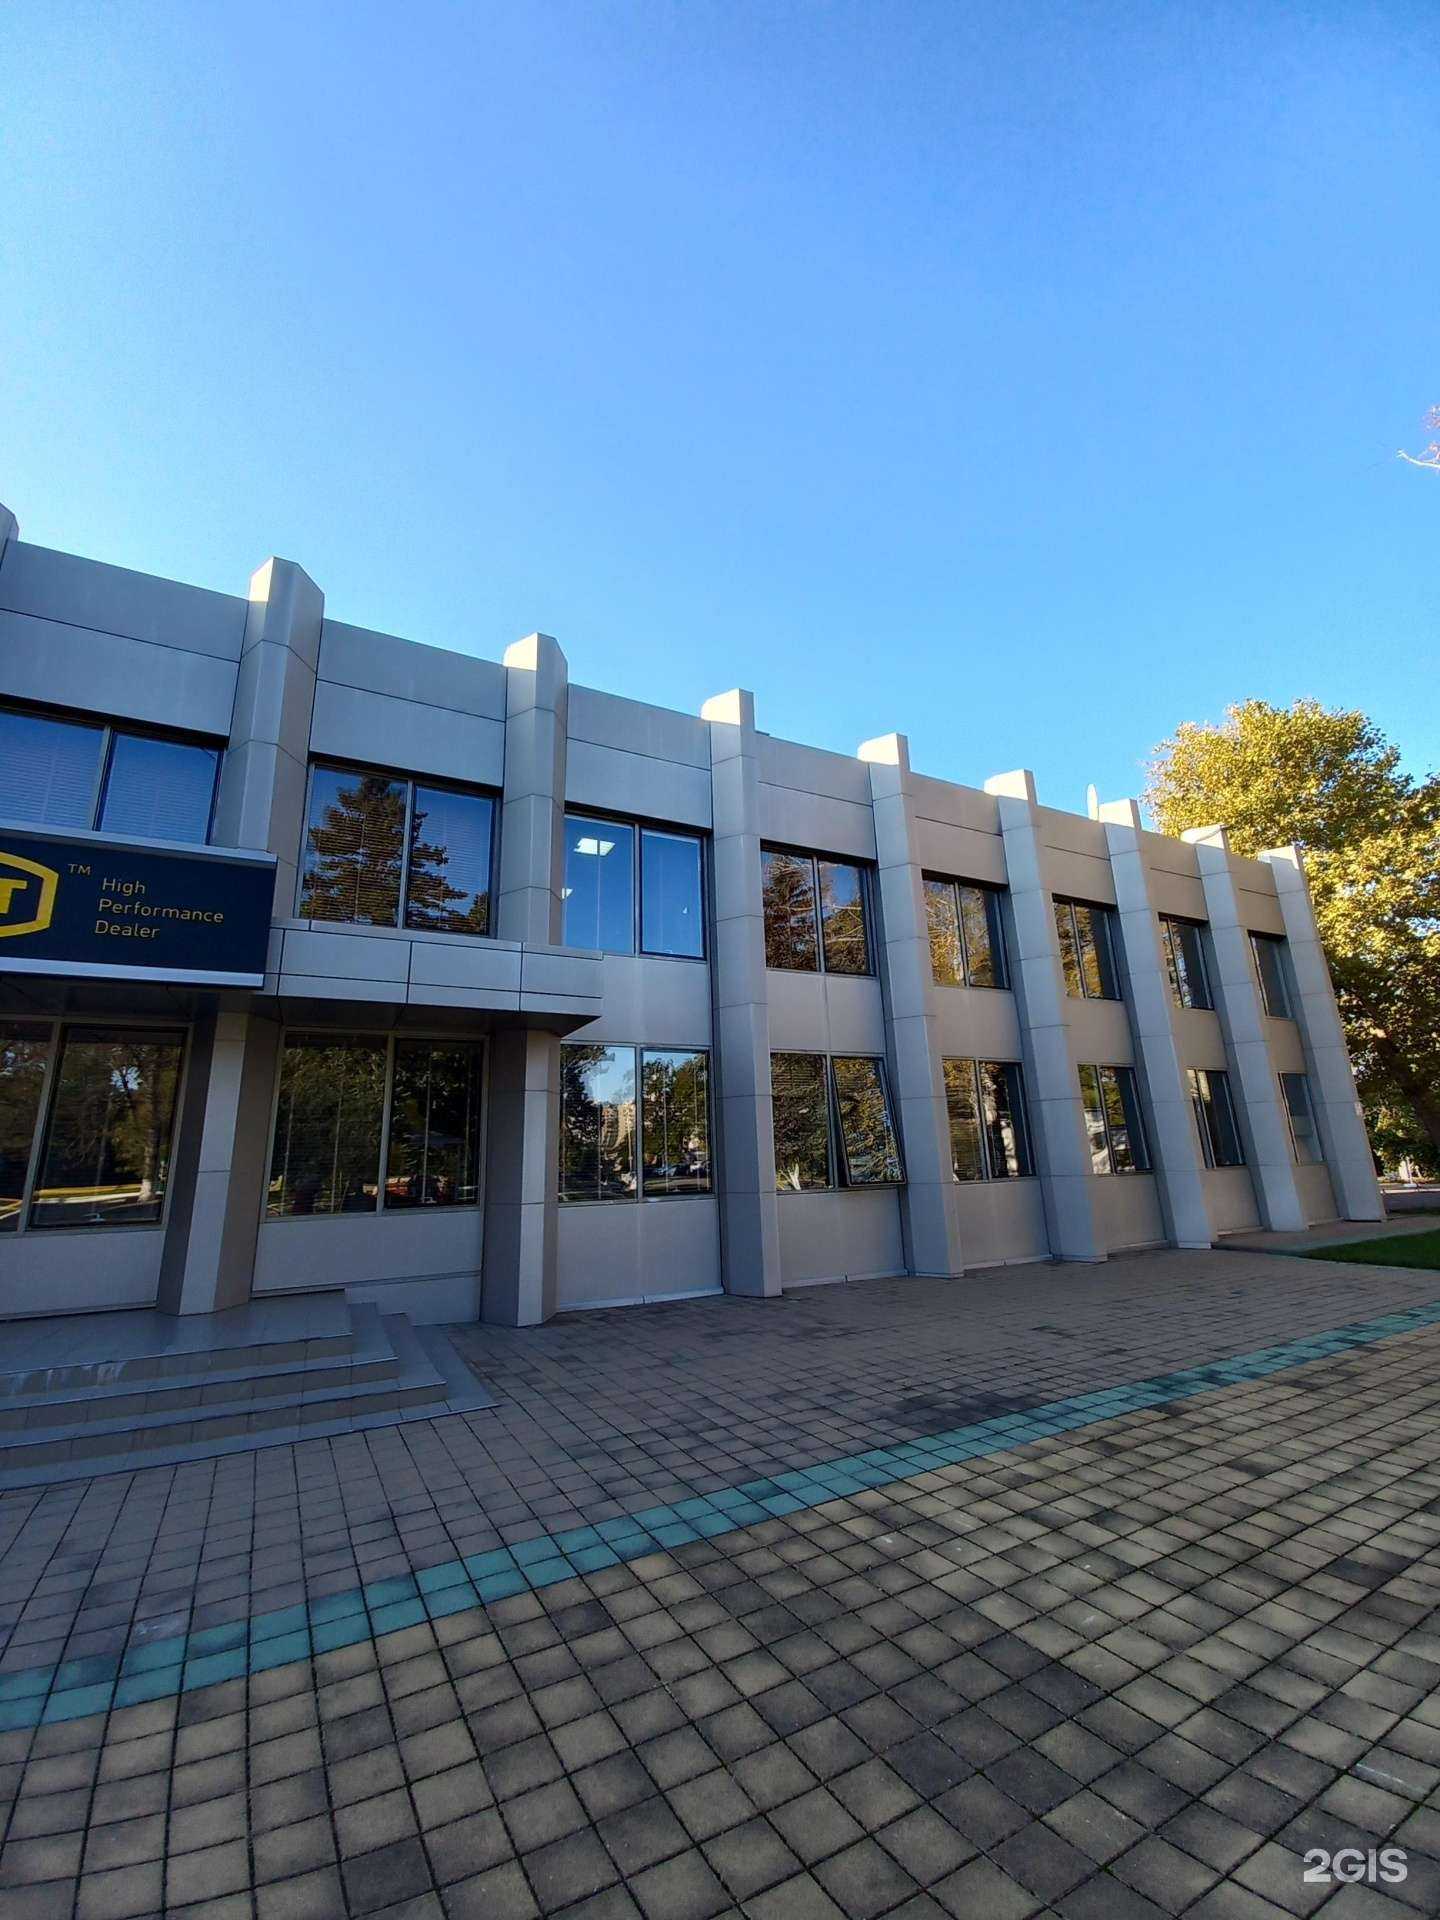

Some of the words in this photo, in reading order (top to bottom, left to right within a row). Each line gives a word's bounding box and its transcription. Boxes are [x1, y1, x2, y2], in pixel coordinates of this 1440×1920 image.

[68, 863, 91, 875] TM
[102, 878, 146, 896] High
[98, 898, 225, 924] Performance
[95, 920, 160, 938] Dealer
